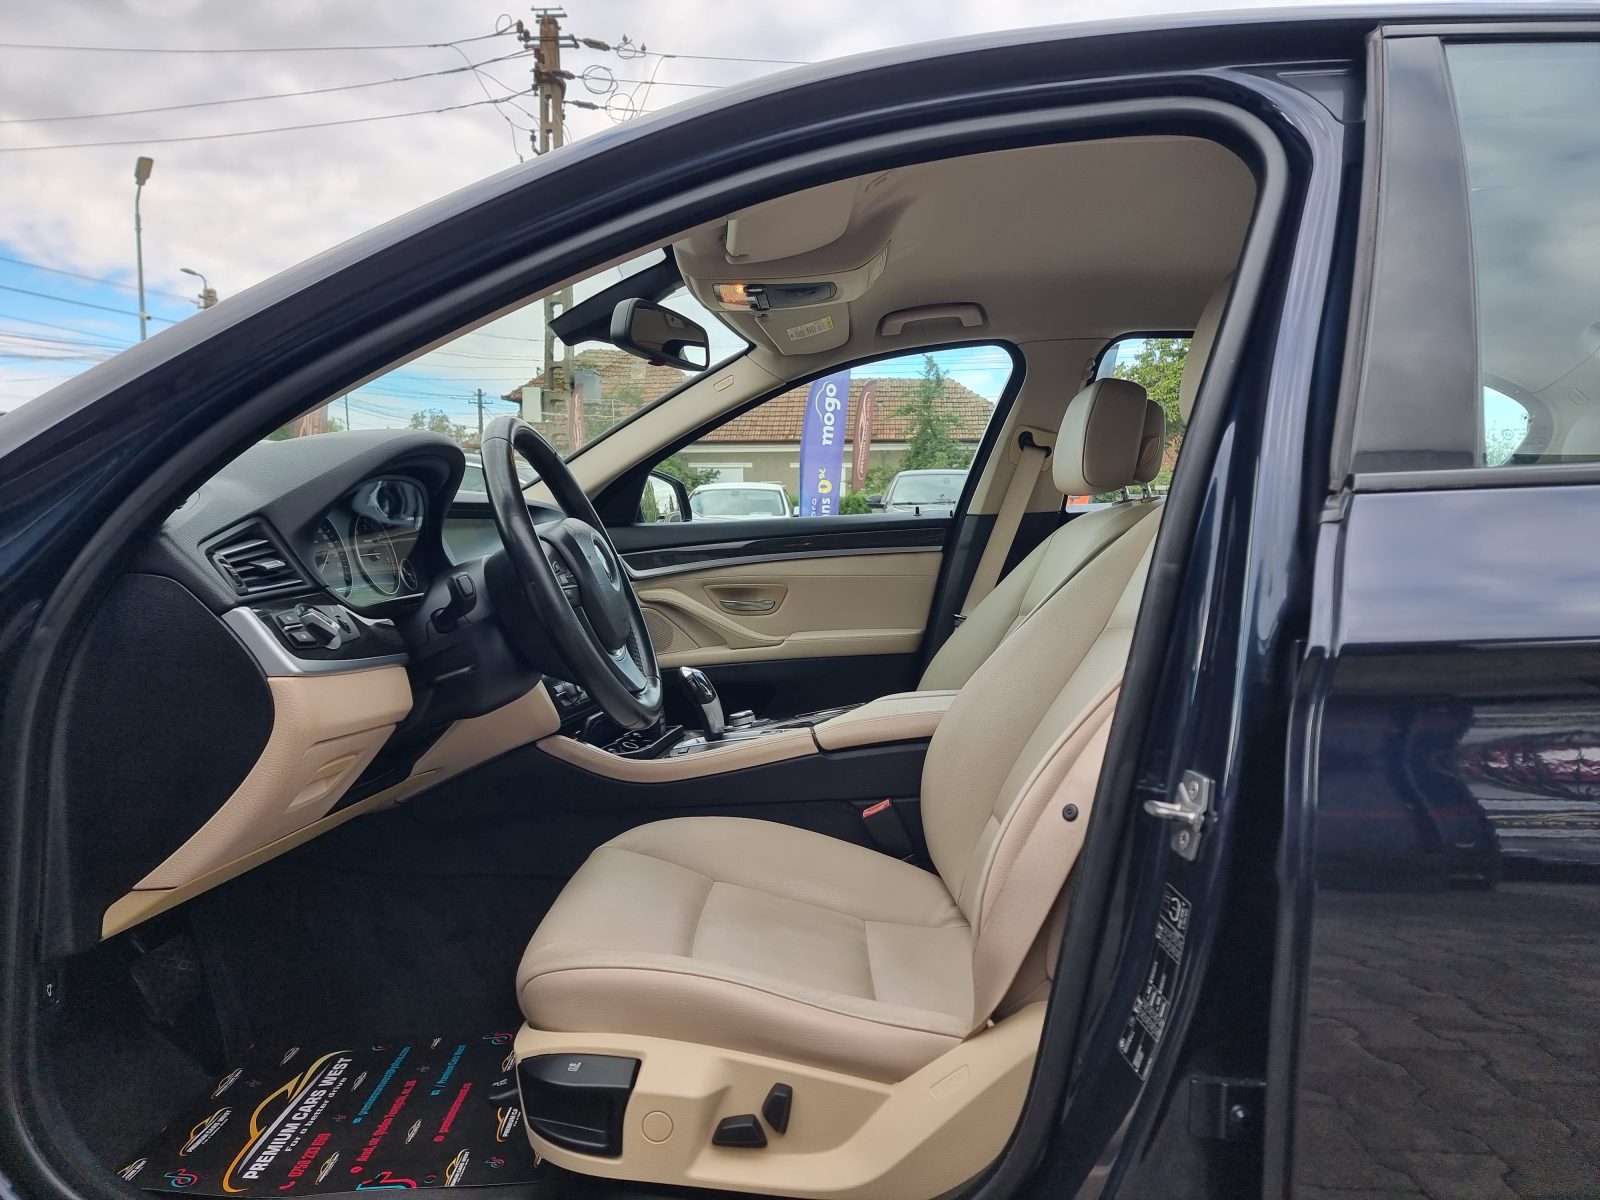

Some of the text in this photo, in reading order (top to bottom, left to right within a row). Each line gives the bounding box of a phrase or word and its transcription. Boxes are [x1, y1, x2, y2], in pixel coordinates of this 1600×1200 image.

[822, 383, 841, 446] mogo
[242, 1122, 301, 1179] PREMIUM
[291, 1089, 327, 1121] CARS
[318, 1057, 353, 1087] WEST
[284, 1137, 301, 1152] For
[305, 1099, 330, 1127] better
[328, 1077, 348, 1098] drive
